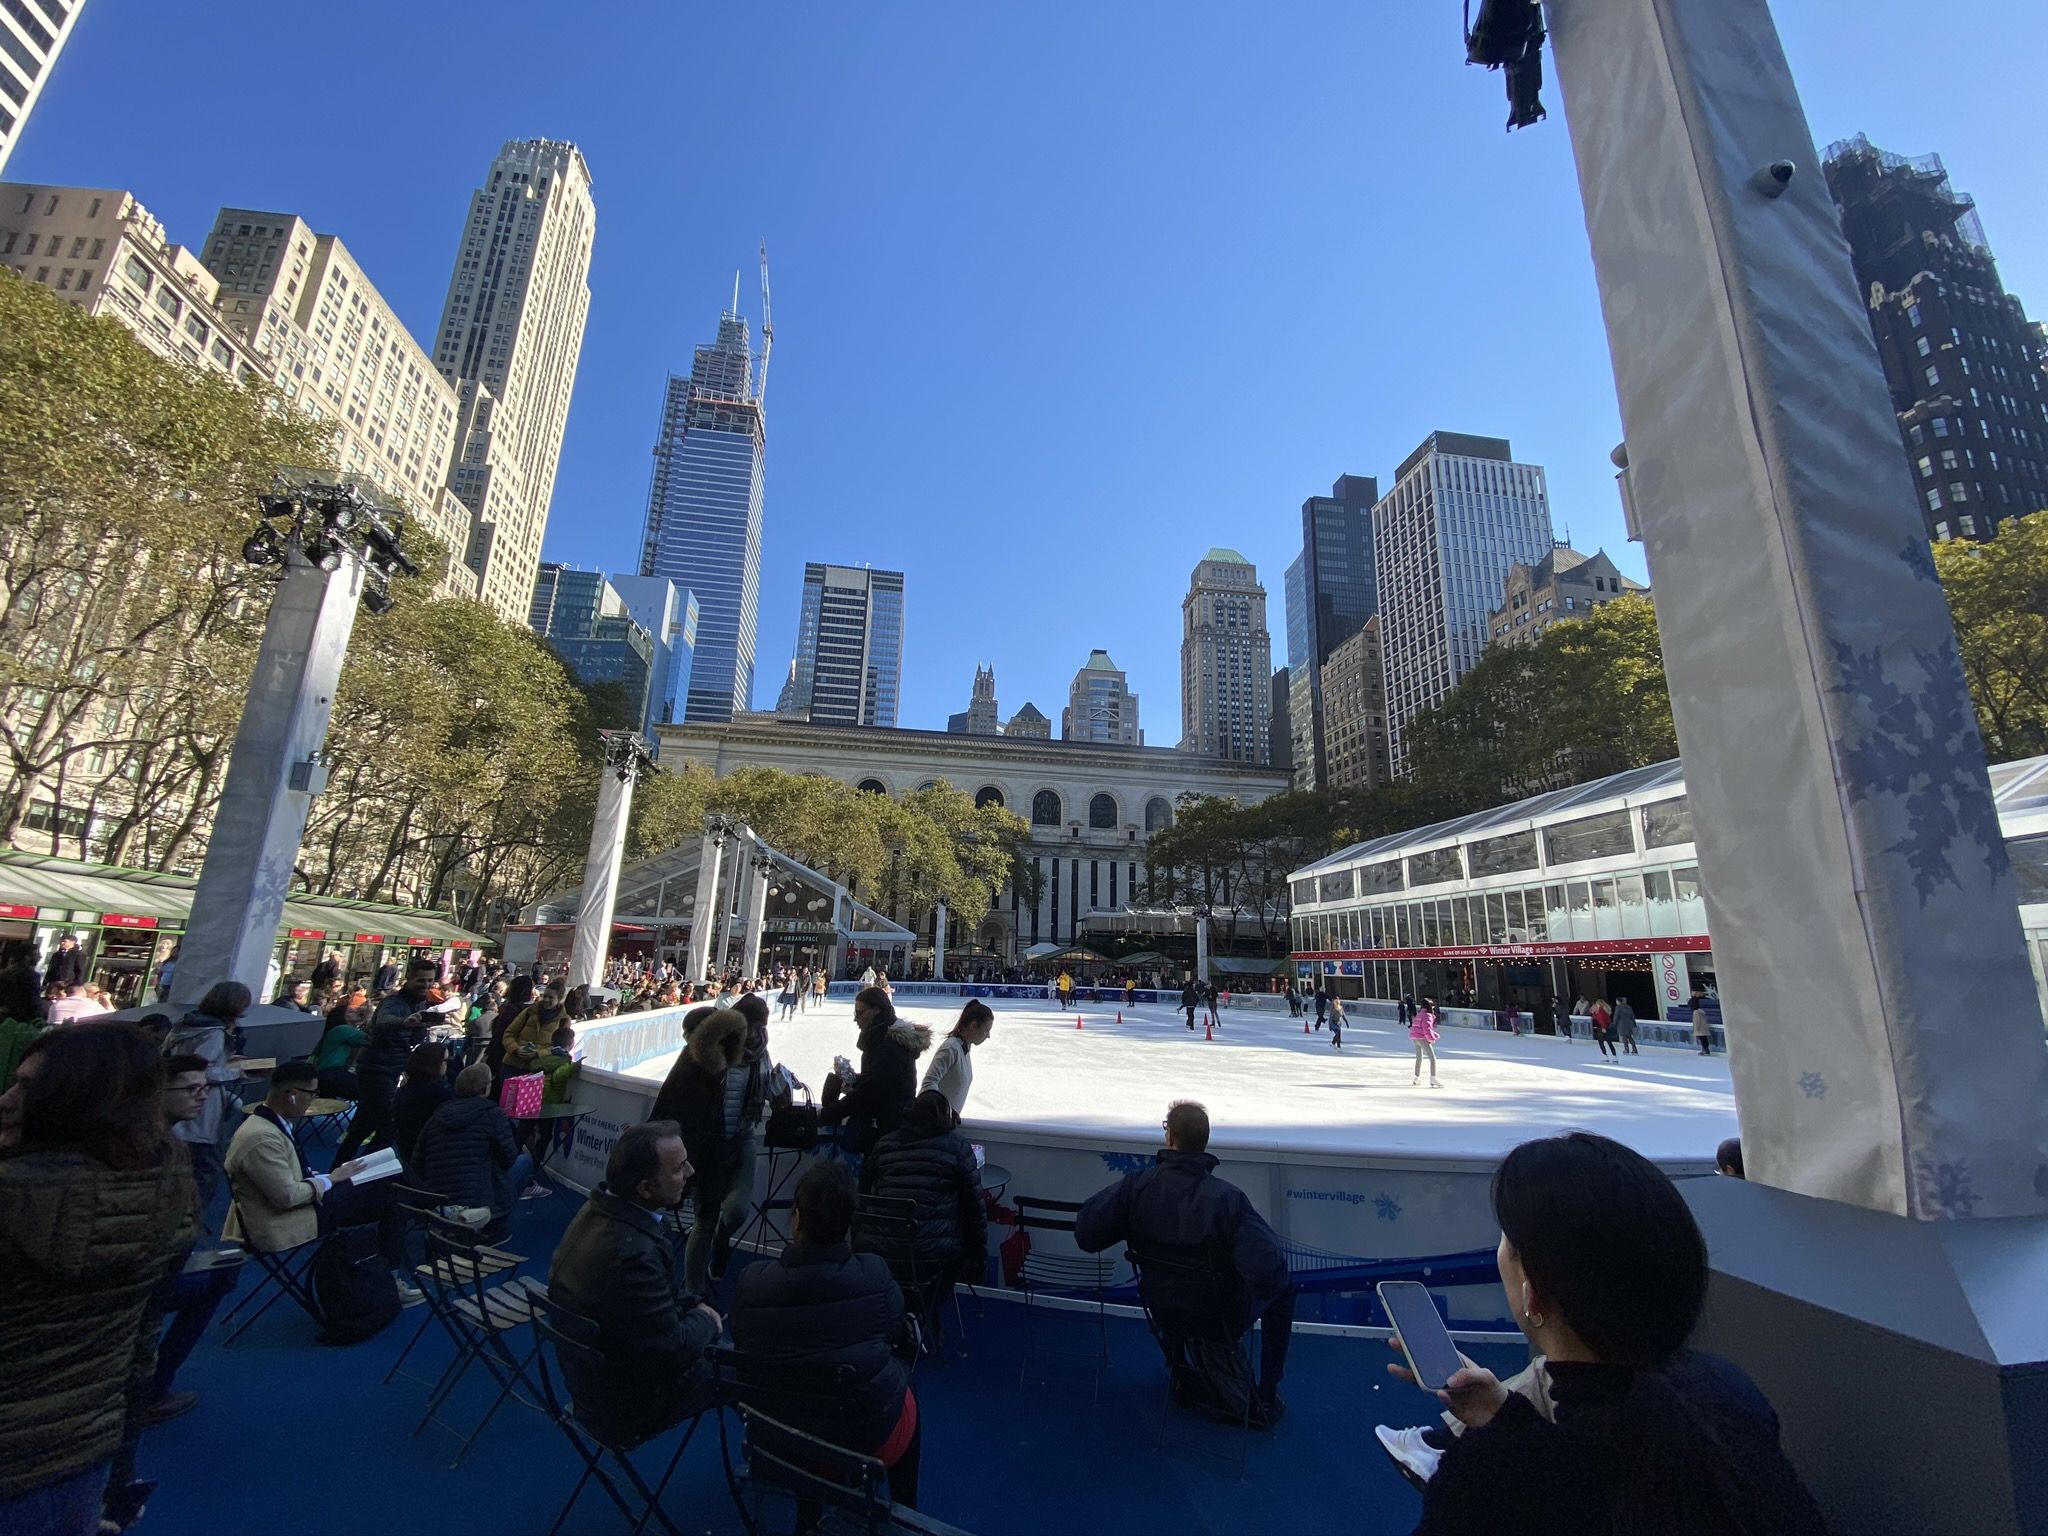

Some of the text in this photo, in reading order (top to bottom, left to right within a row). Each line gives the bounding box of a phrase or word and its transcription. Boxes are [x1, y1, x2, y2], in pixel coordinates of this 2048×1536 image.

[1489, 946, 1510, 955] Winter
[1510, 945, 1533, 957] Village
[1541, 946, 1556, 955] Bryant
[1556, 945, 1567, 954] Park
[598, 1120, 619, 1132] AMERICA
[577, 1128, 603, 1152] Winter
[1286, 1189, 1365, 1204] #wintervillage
